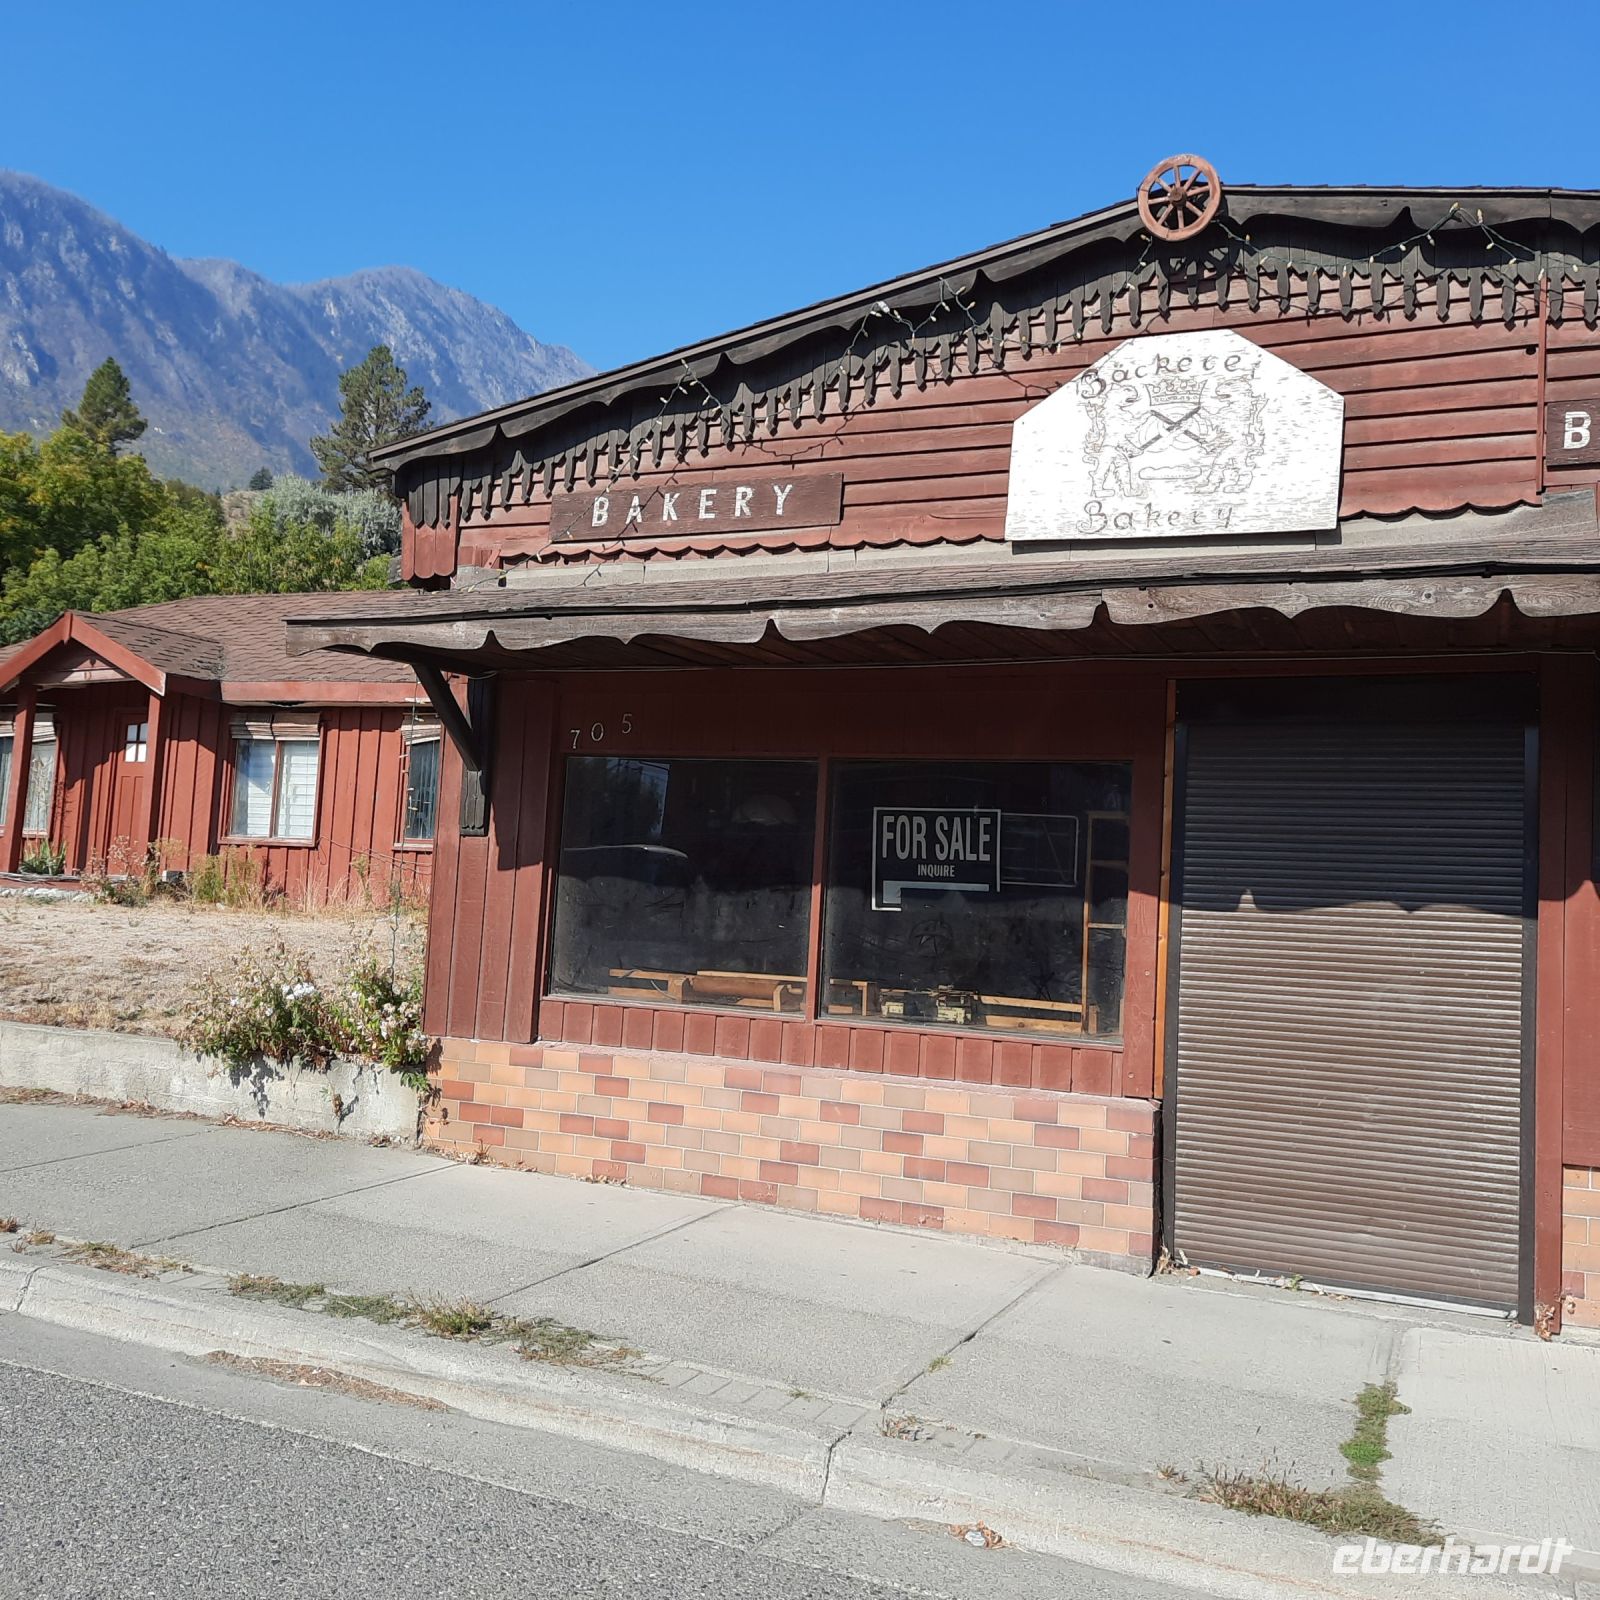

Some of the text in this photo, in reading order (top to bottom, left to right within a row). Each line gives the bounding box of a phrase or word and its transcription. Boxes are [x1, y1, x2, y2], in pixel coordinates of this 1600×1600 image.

[1564, 411, 1591, 449] B
[591, 484, 793, 527] BAKERY
[1075, 500, 1233, 533] Bakery
[882, 815, 991, 861] FOR SALE
[917, 864, 955, 877] INQUIRE
